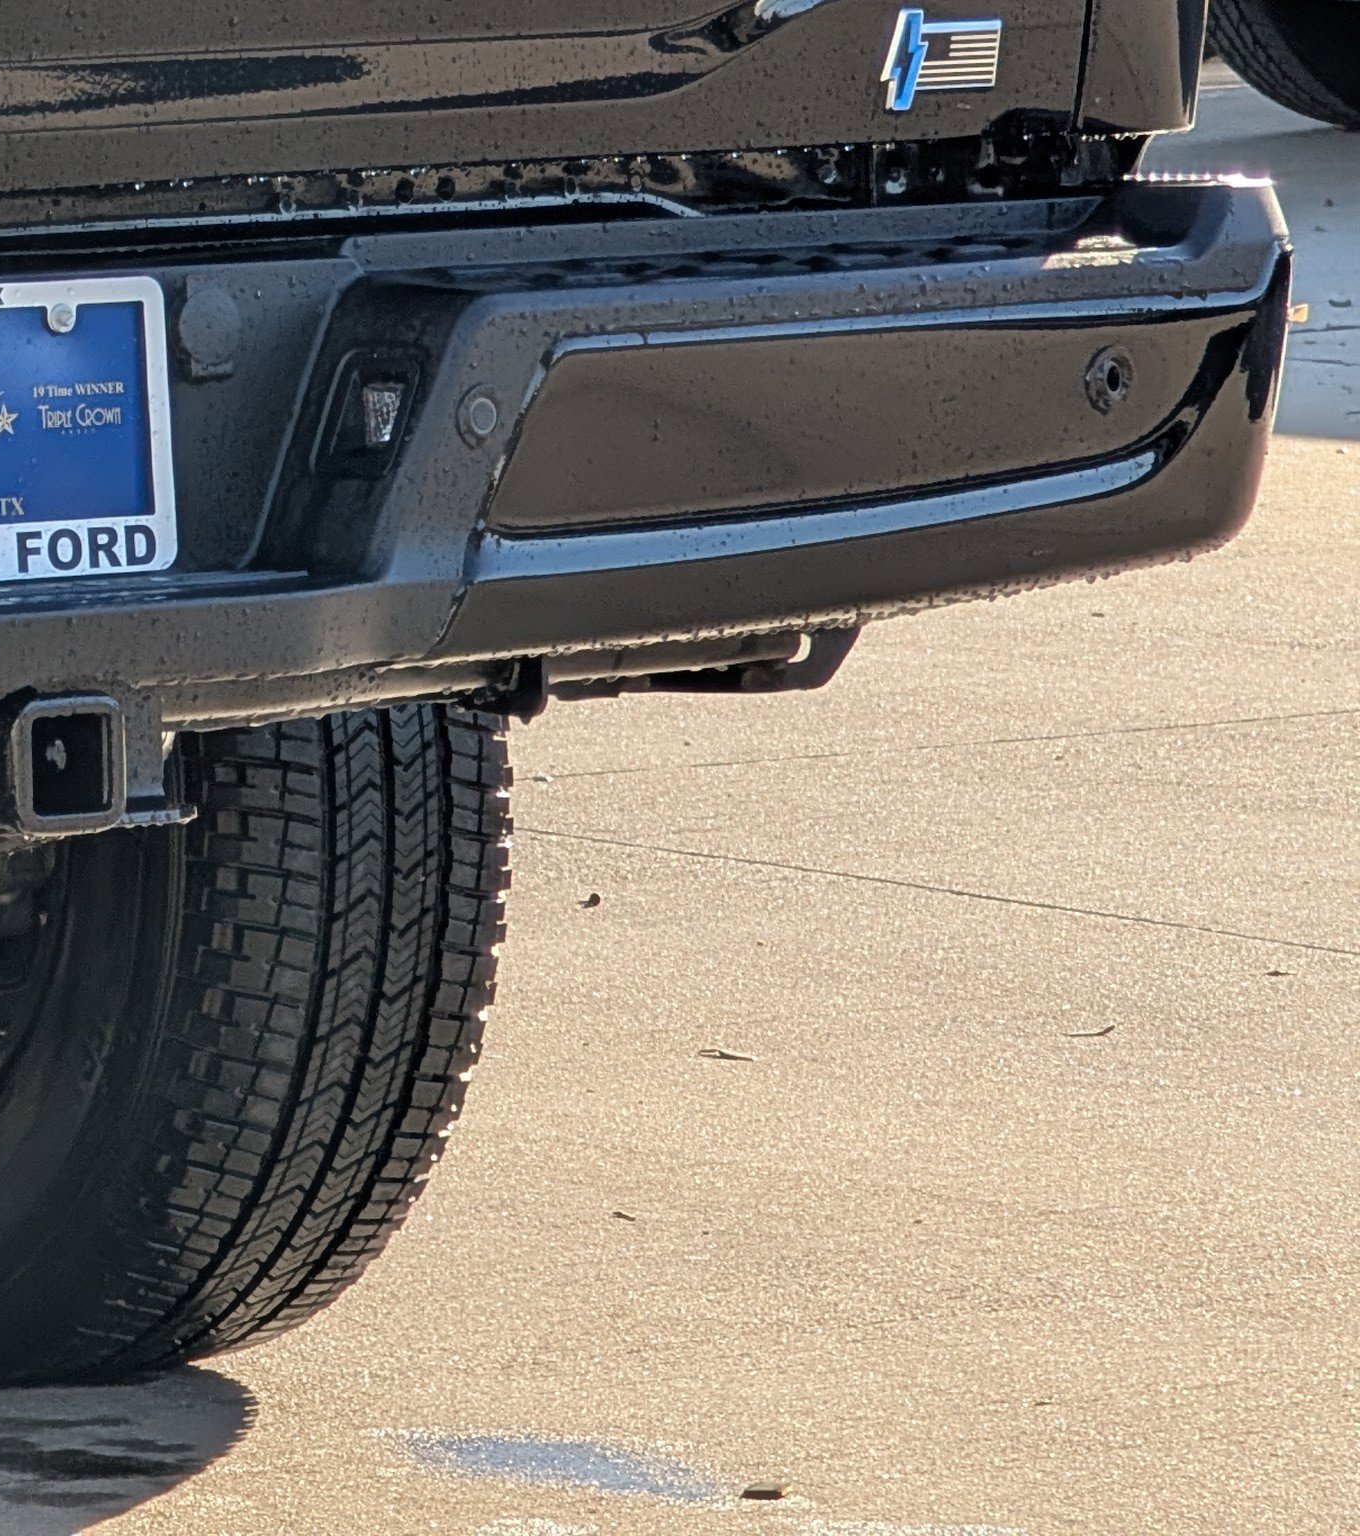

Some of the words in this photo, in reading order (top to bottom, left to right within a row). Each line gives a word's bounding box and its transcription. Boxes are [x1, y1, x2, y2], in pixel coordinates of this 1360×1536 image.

[33, 385, 44, 399] 19
[46, 384, 73, 398] Time
[74, 381, 125, 395] WINNER
[16, 524, 158, 574] FORD
